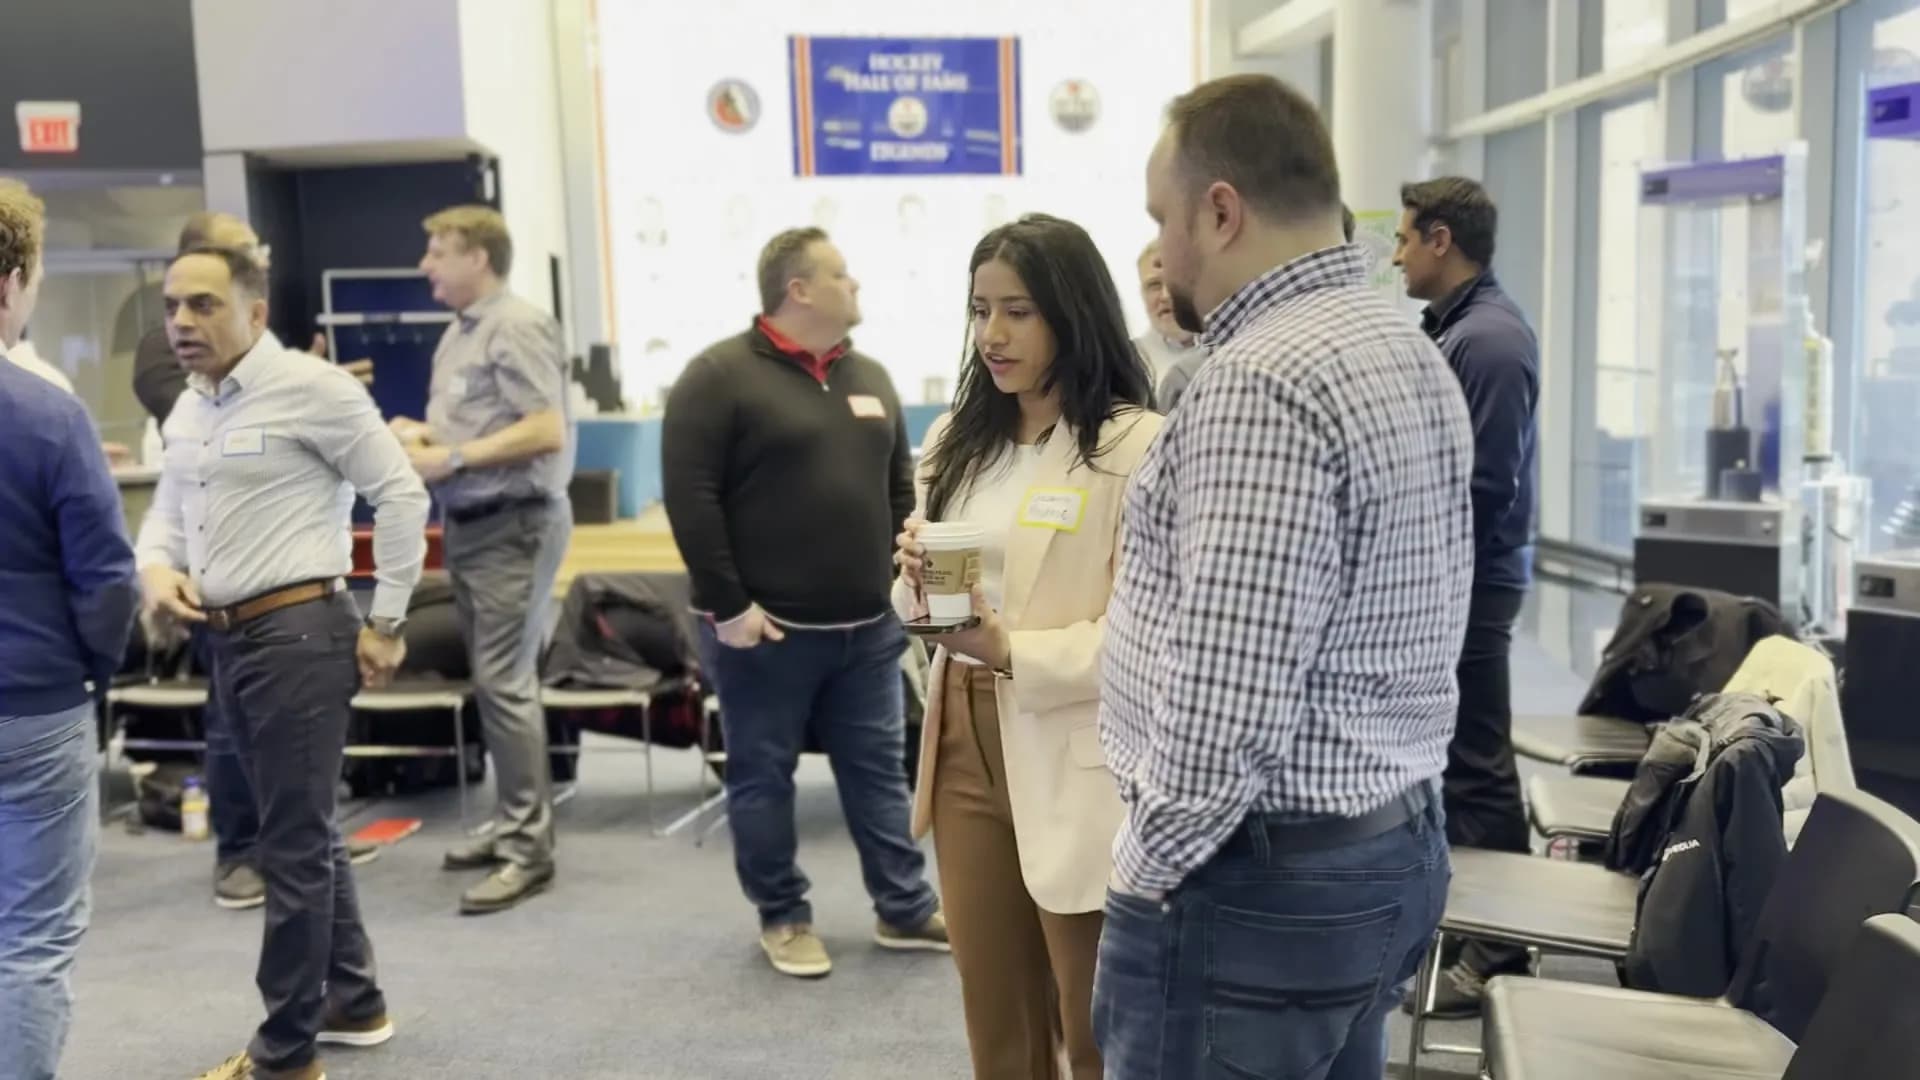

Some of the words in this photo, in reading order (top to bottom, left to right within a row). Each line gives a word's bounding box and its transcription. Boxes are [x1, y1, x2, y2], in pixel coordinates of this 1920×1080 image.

[869, 53, 944, 71] HOCKEY
[845, 72, 890, 92] HALL
[893, 72, 917, 92] OF
[921, 72, 969, 92] FAME
[28, 117, 72, 150] EXIT
